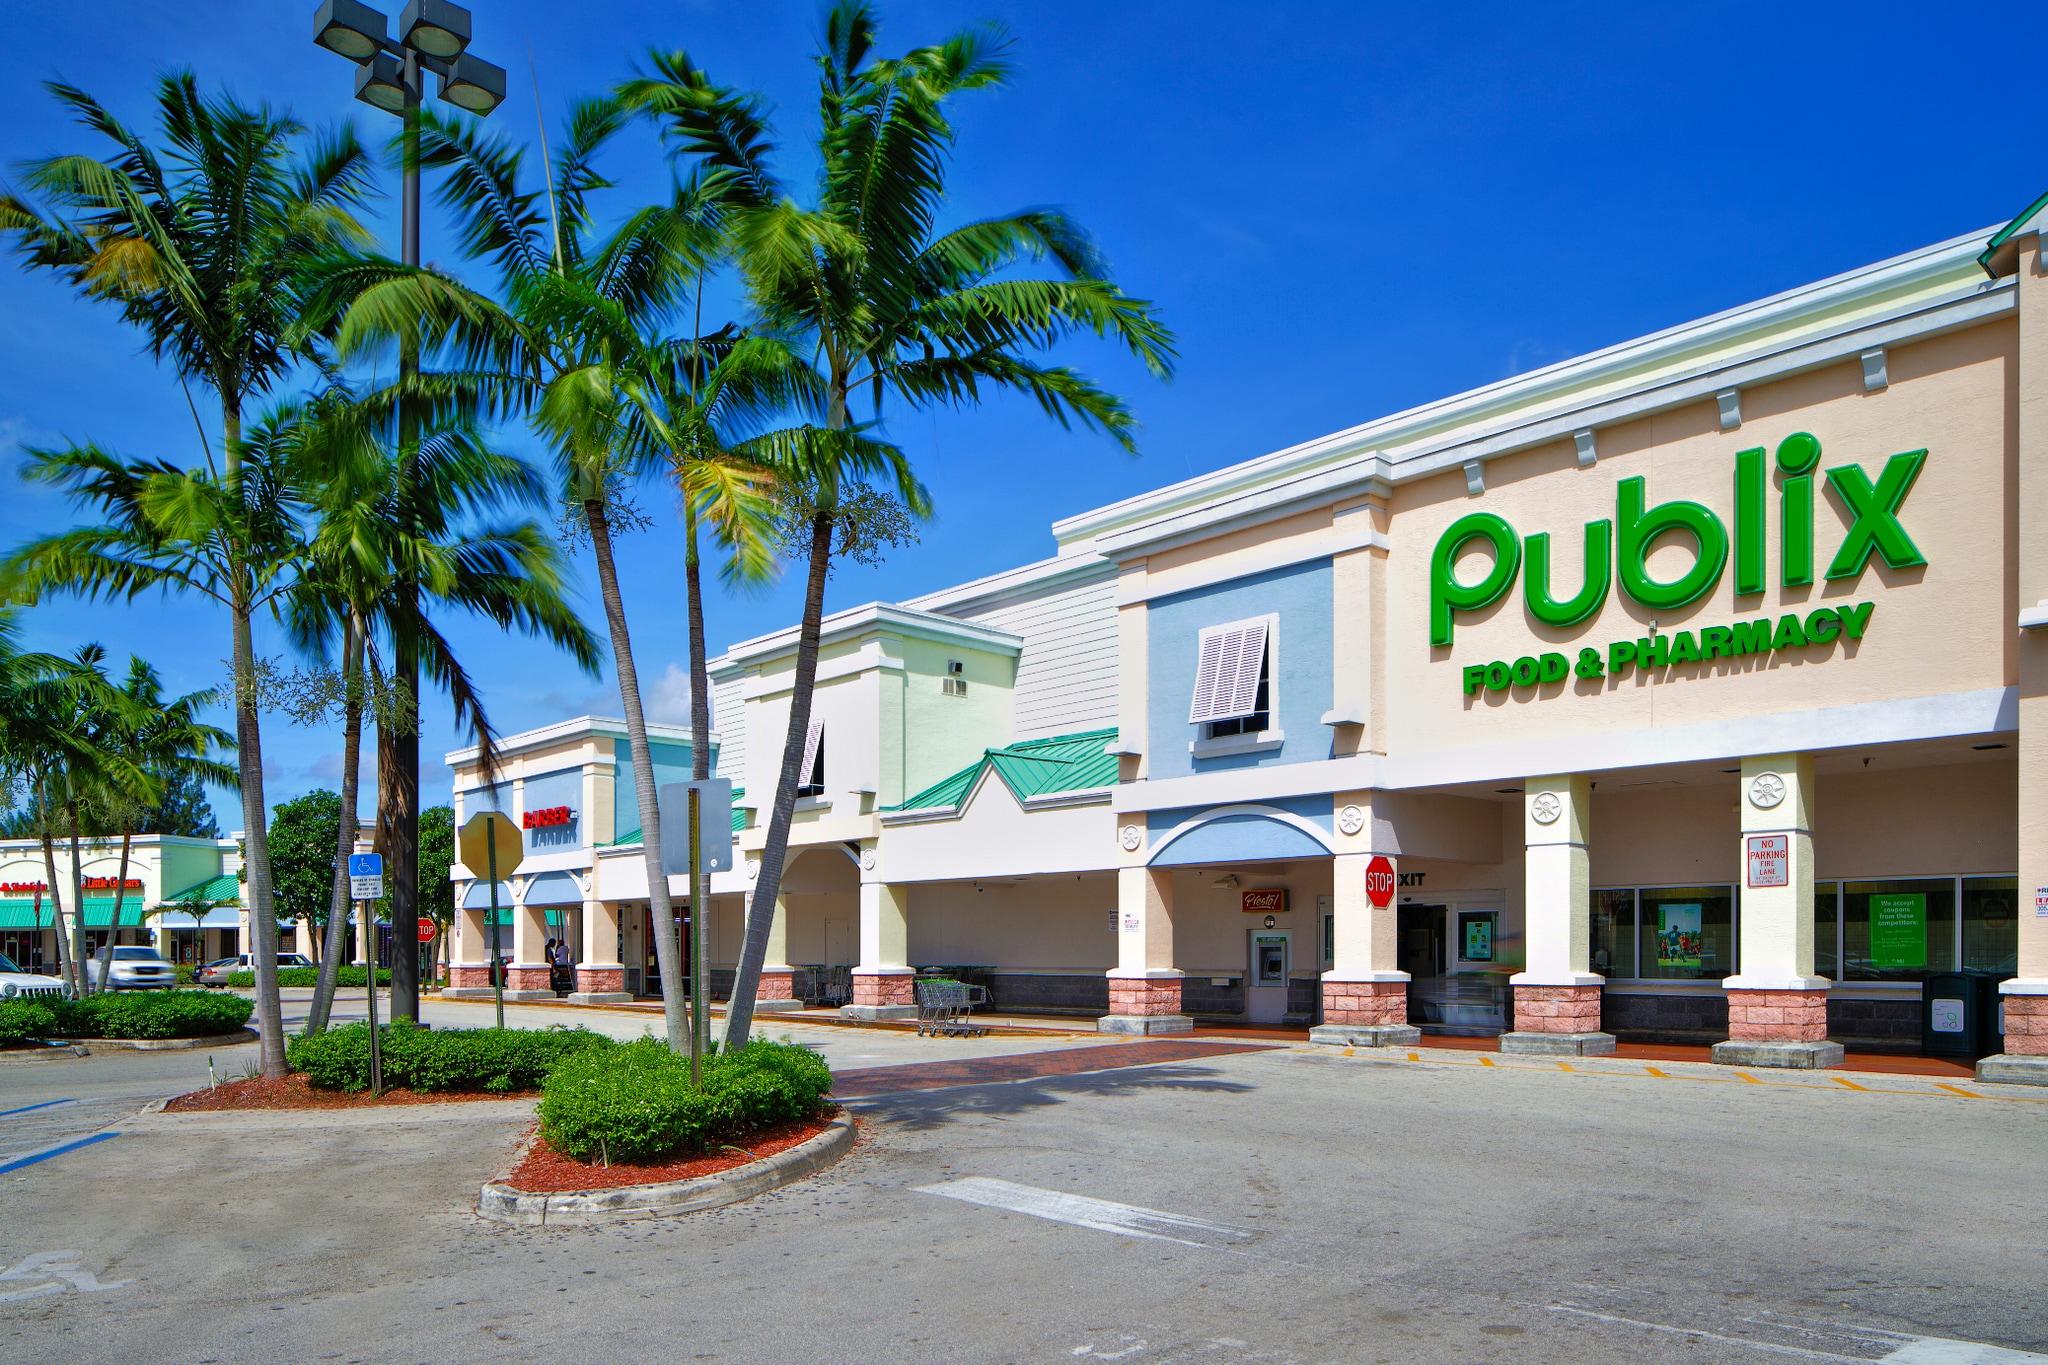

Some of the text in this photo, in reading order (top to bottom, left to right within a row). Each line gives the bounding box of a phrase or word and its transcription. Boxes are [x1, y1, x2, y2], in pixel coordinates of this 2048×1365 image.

[1463, 601, 1876, 695] FOOD & PHARMACY
[523, 806, 569, 829] BARBER
[1761, 840, 1774, 848] NO
[1750, 850, 1785, 860] PARKING
[1367, 872, 1393, 892] STOP
[1398, 872, 1426, 886] XIT
[1245, 893, 1280, 909] Presto!
[418, 925, 434, 935] TOP
